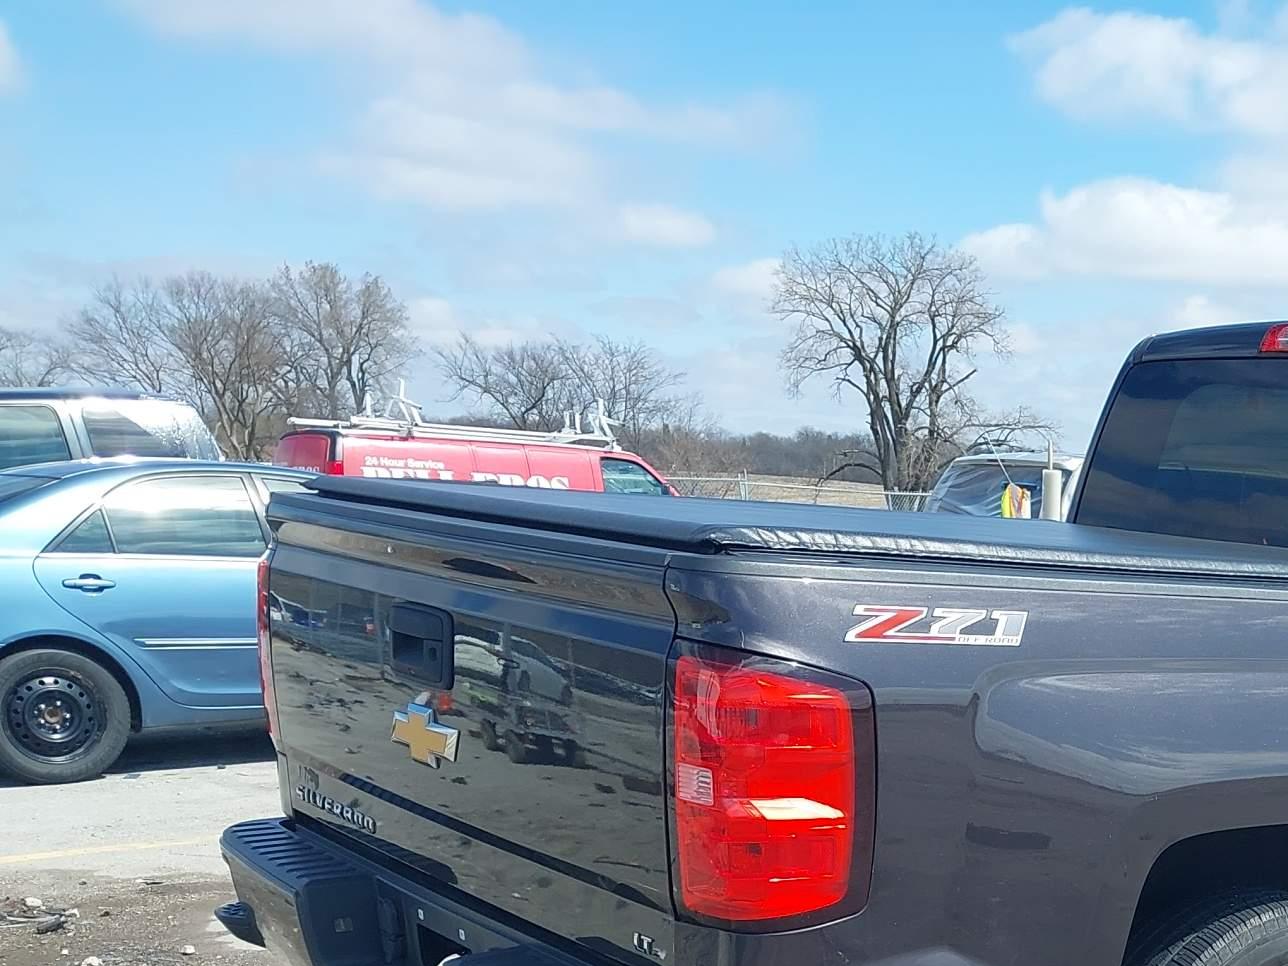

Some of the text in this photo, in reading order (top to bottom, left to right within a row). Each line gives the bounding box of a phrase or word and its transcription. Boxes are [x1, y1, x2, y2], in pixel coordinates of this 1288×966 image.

[364, 456, 445, 470] 24 Hour Service
[843, 604, 1029, 646] Z71
[295, 783, 377, 834] SILVERADO
